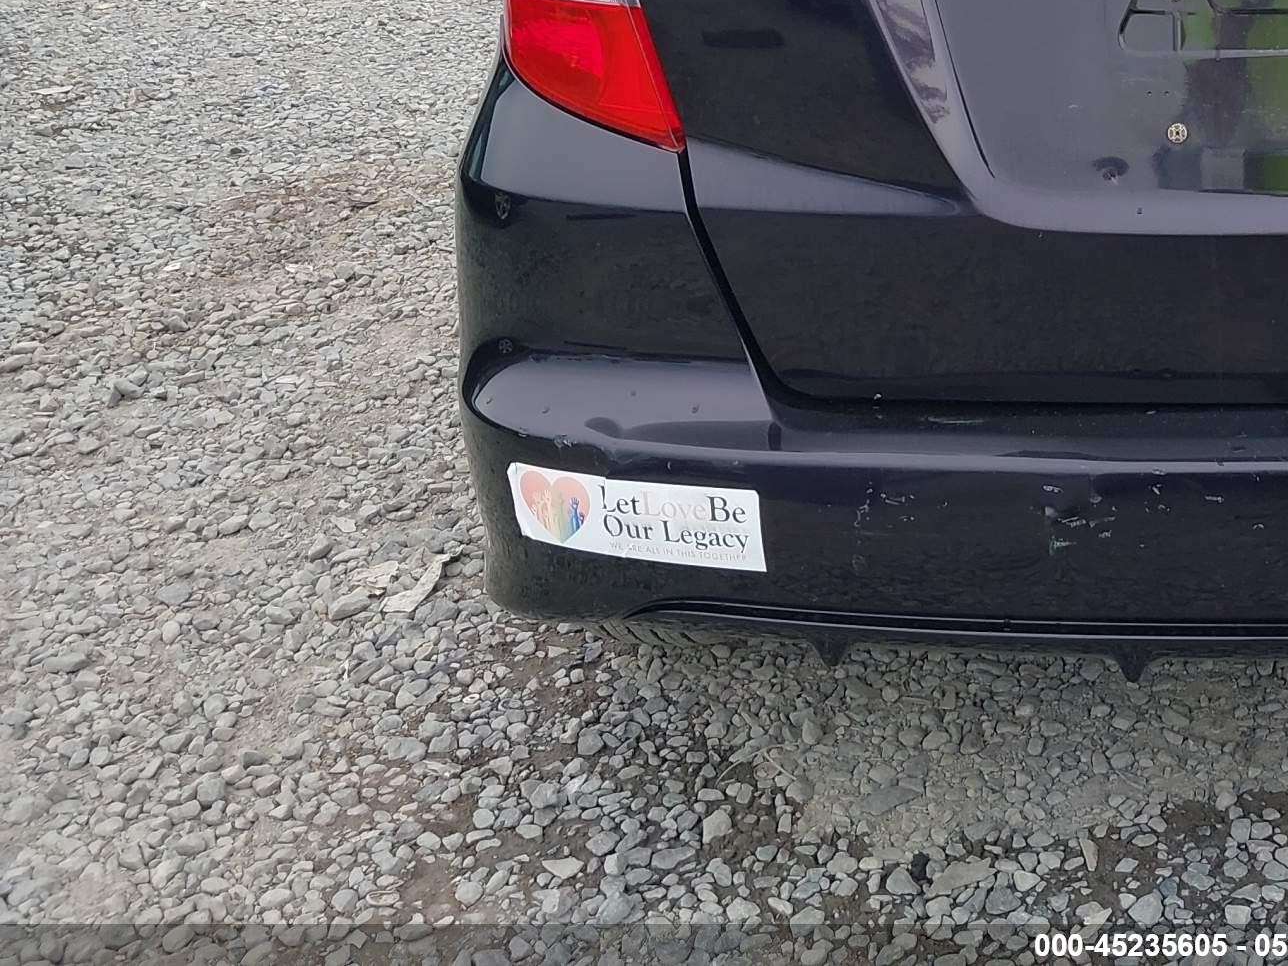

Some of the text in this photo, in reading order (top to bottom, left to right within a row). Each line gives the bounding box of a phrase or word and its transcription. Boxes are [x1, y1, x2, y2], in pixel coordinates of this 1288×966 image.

[603, 514, 749, 553] Our Legacy
[663, 548, 674, 556] IN
[677, 549, 696, 558] THIS
